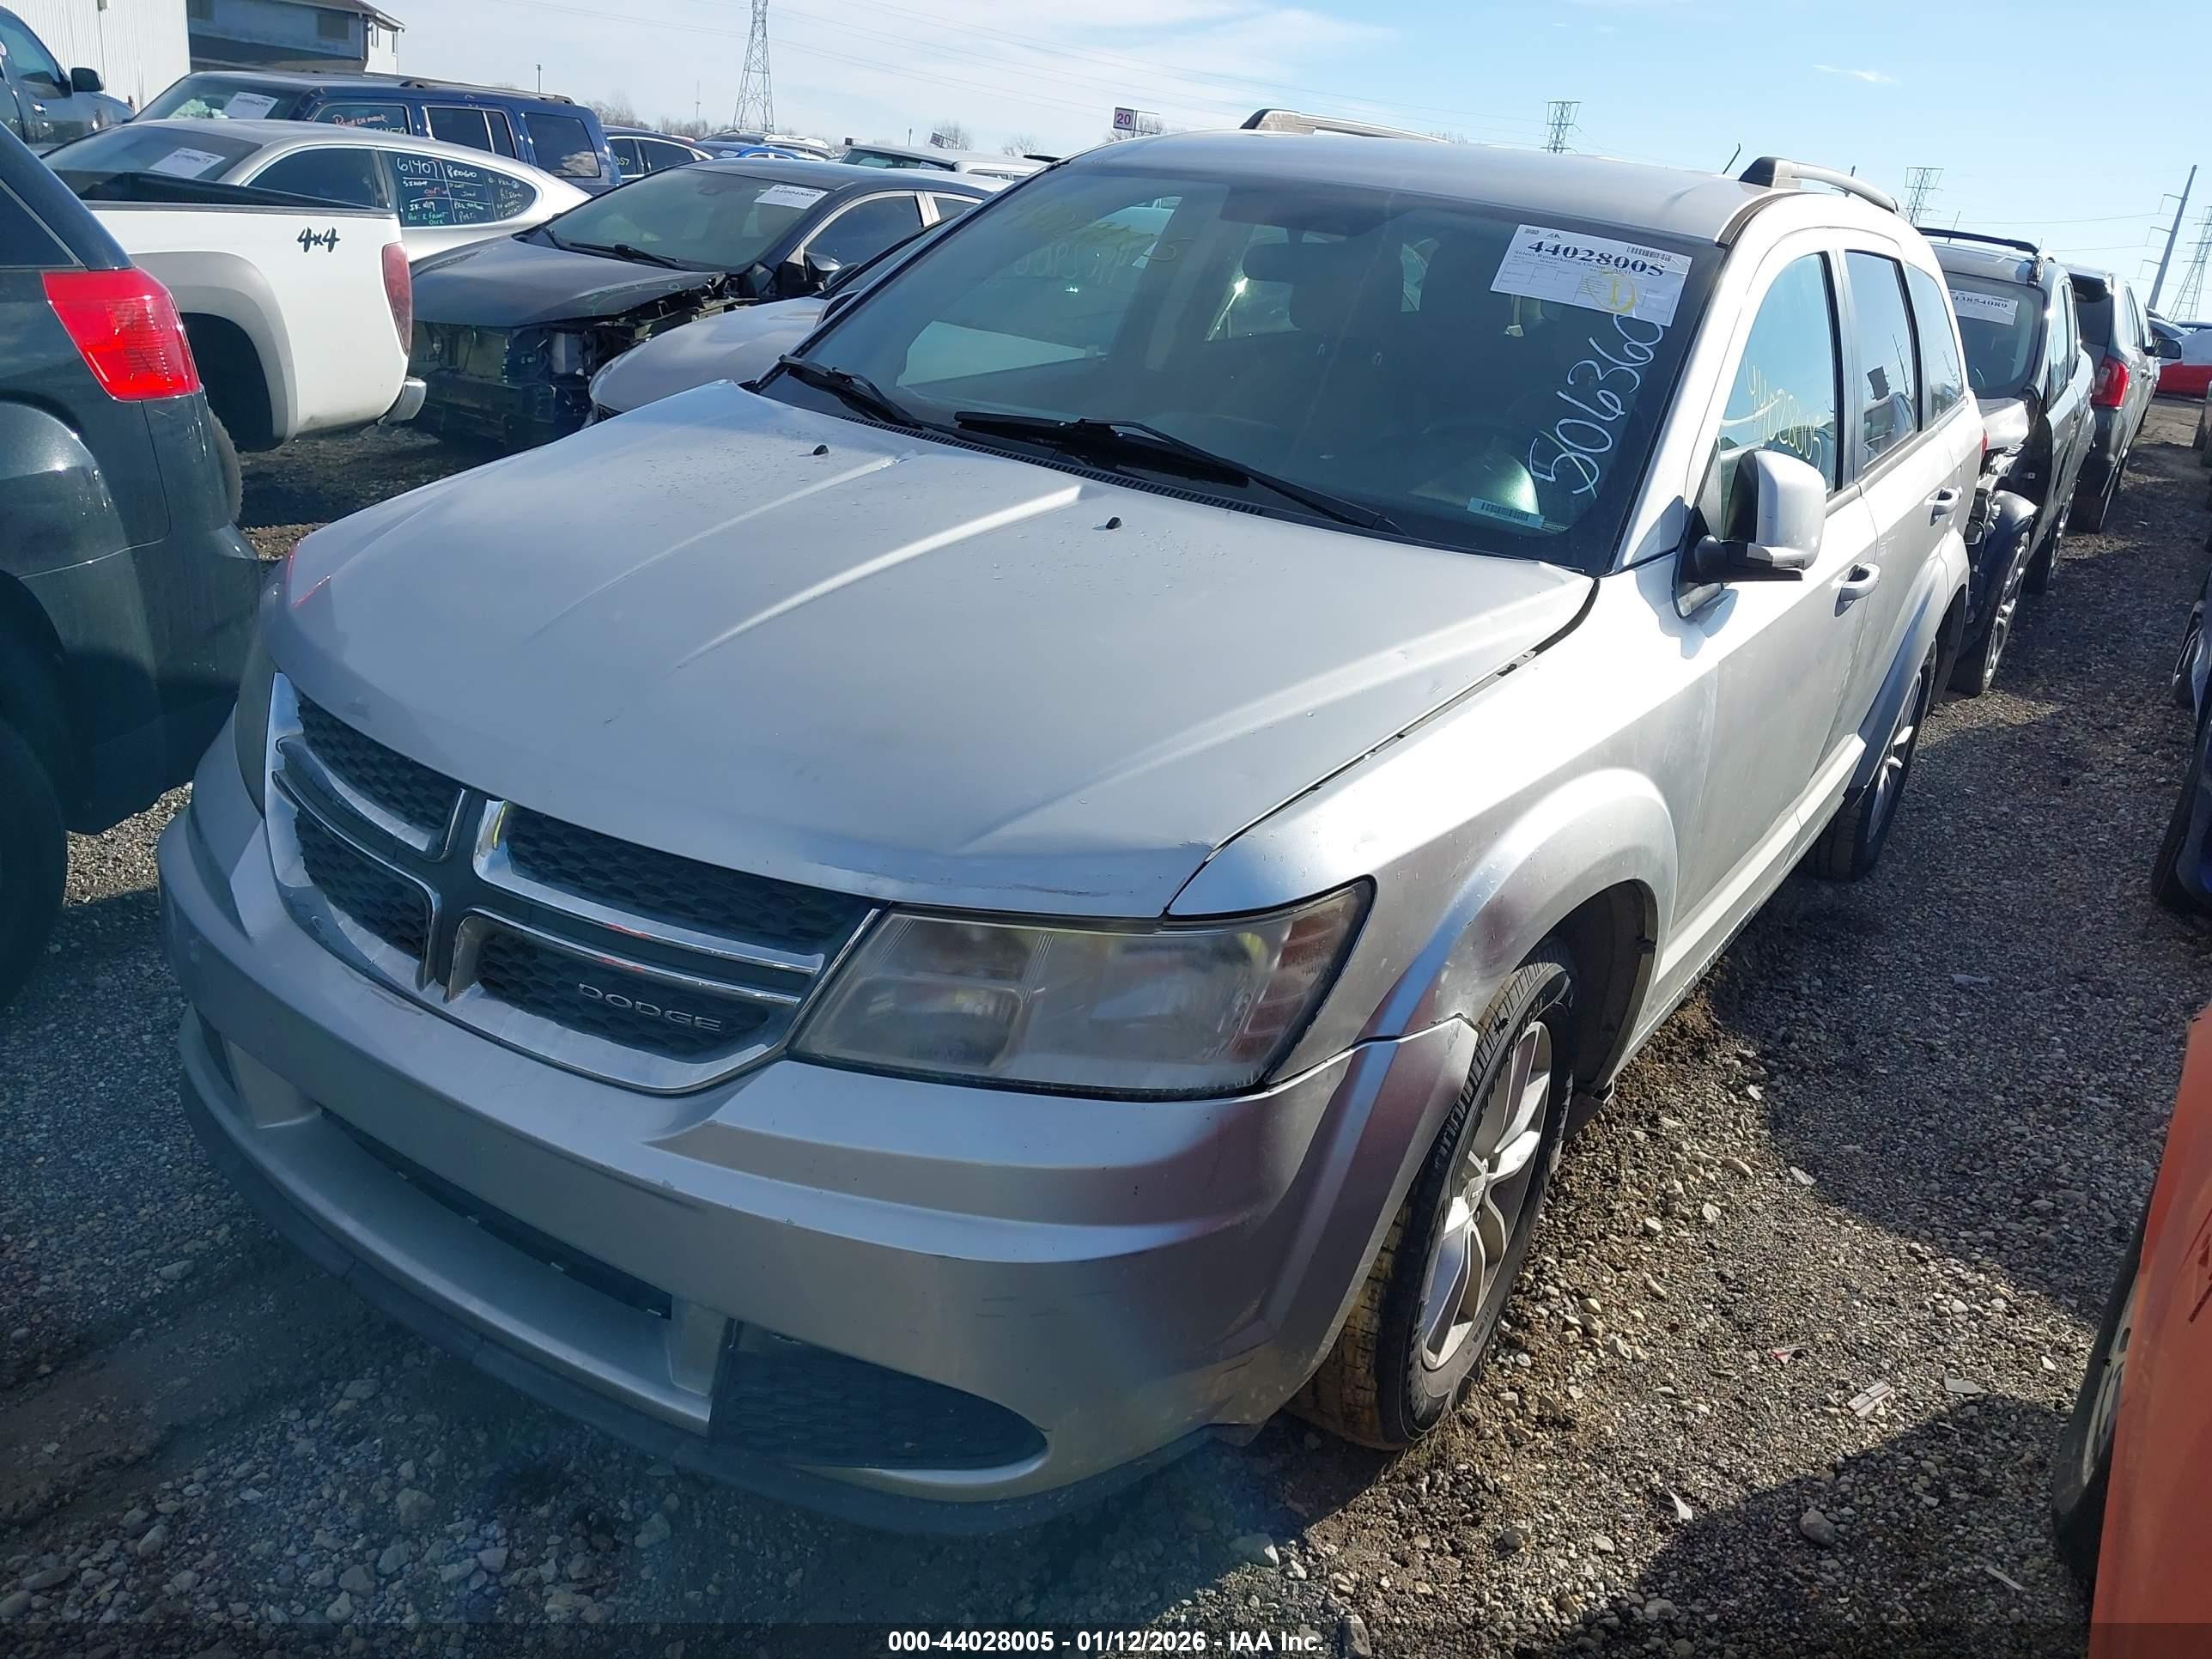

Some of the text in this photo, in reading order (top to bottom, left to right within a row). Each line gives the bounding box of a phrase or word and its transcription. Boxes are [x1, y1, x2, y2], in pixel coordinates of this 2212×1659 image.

[1116, 113, 1131, 125] 20
[397, 157, 439, 179] 61407
[296, 226, 341, 253] 4x4
[1528, 240, 1666, 276] 44028005
[578, 982, 722, 1031] DODGE
